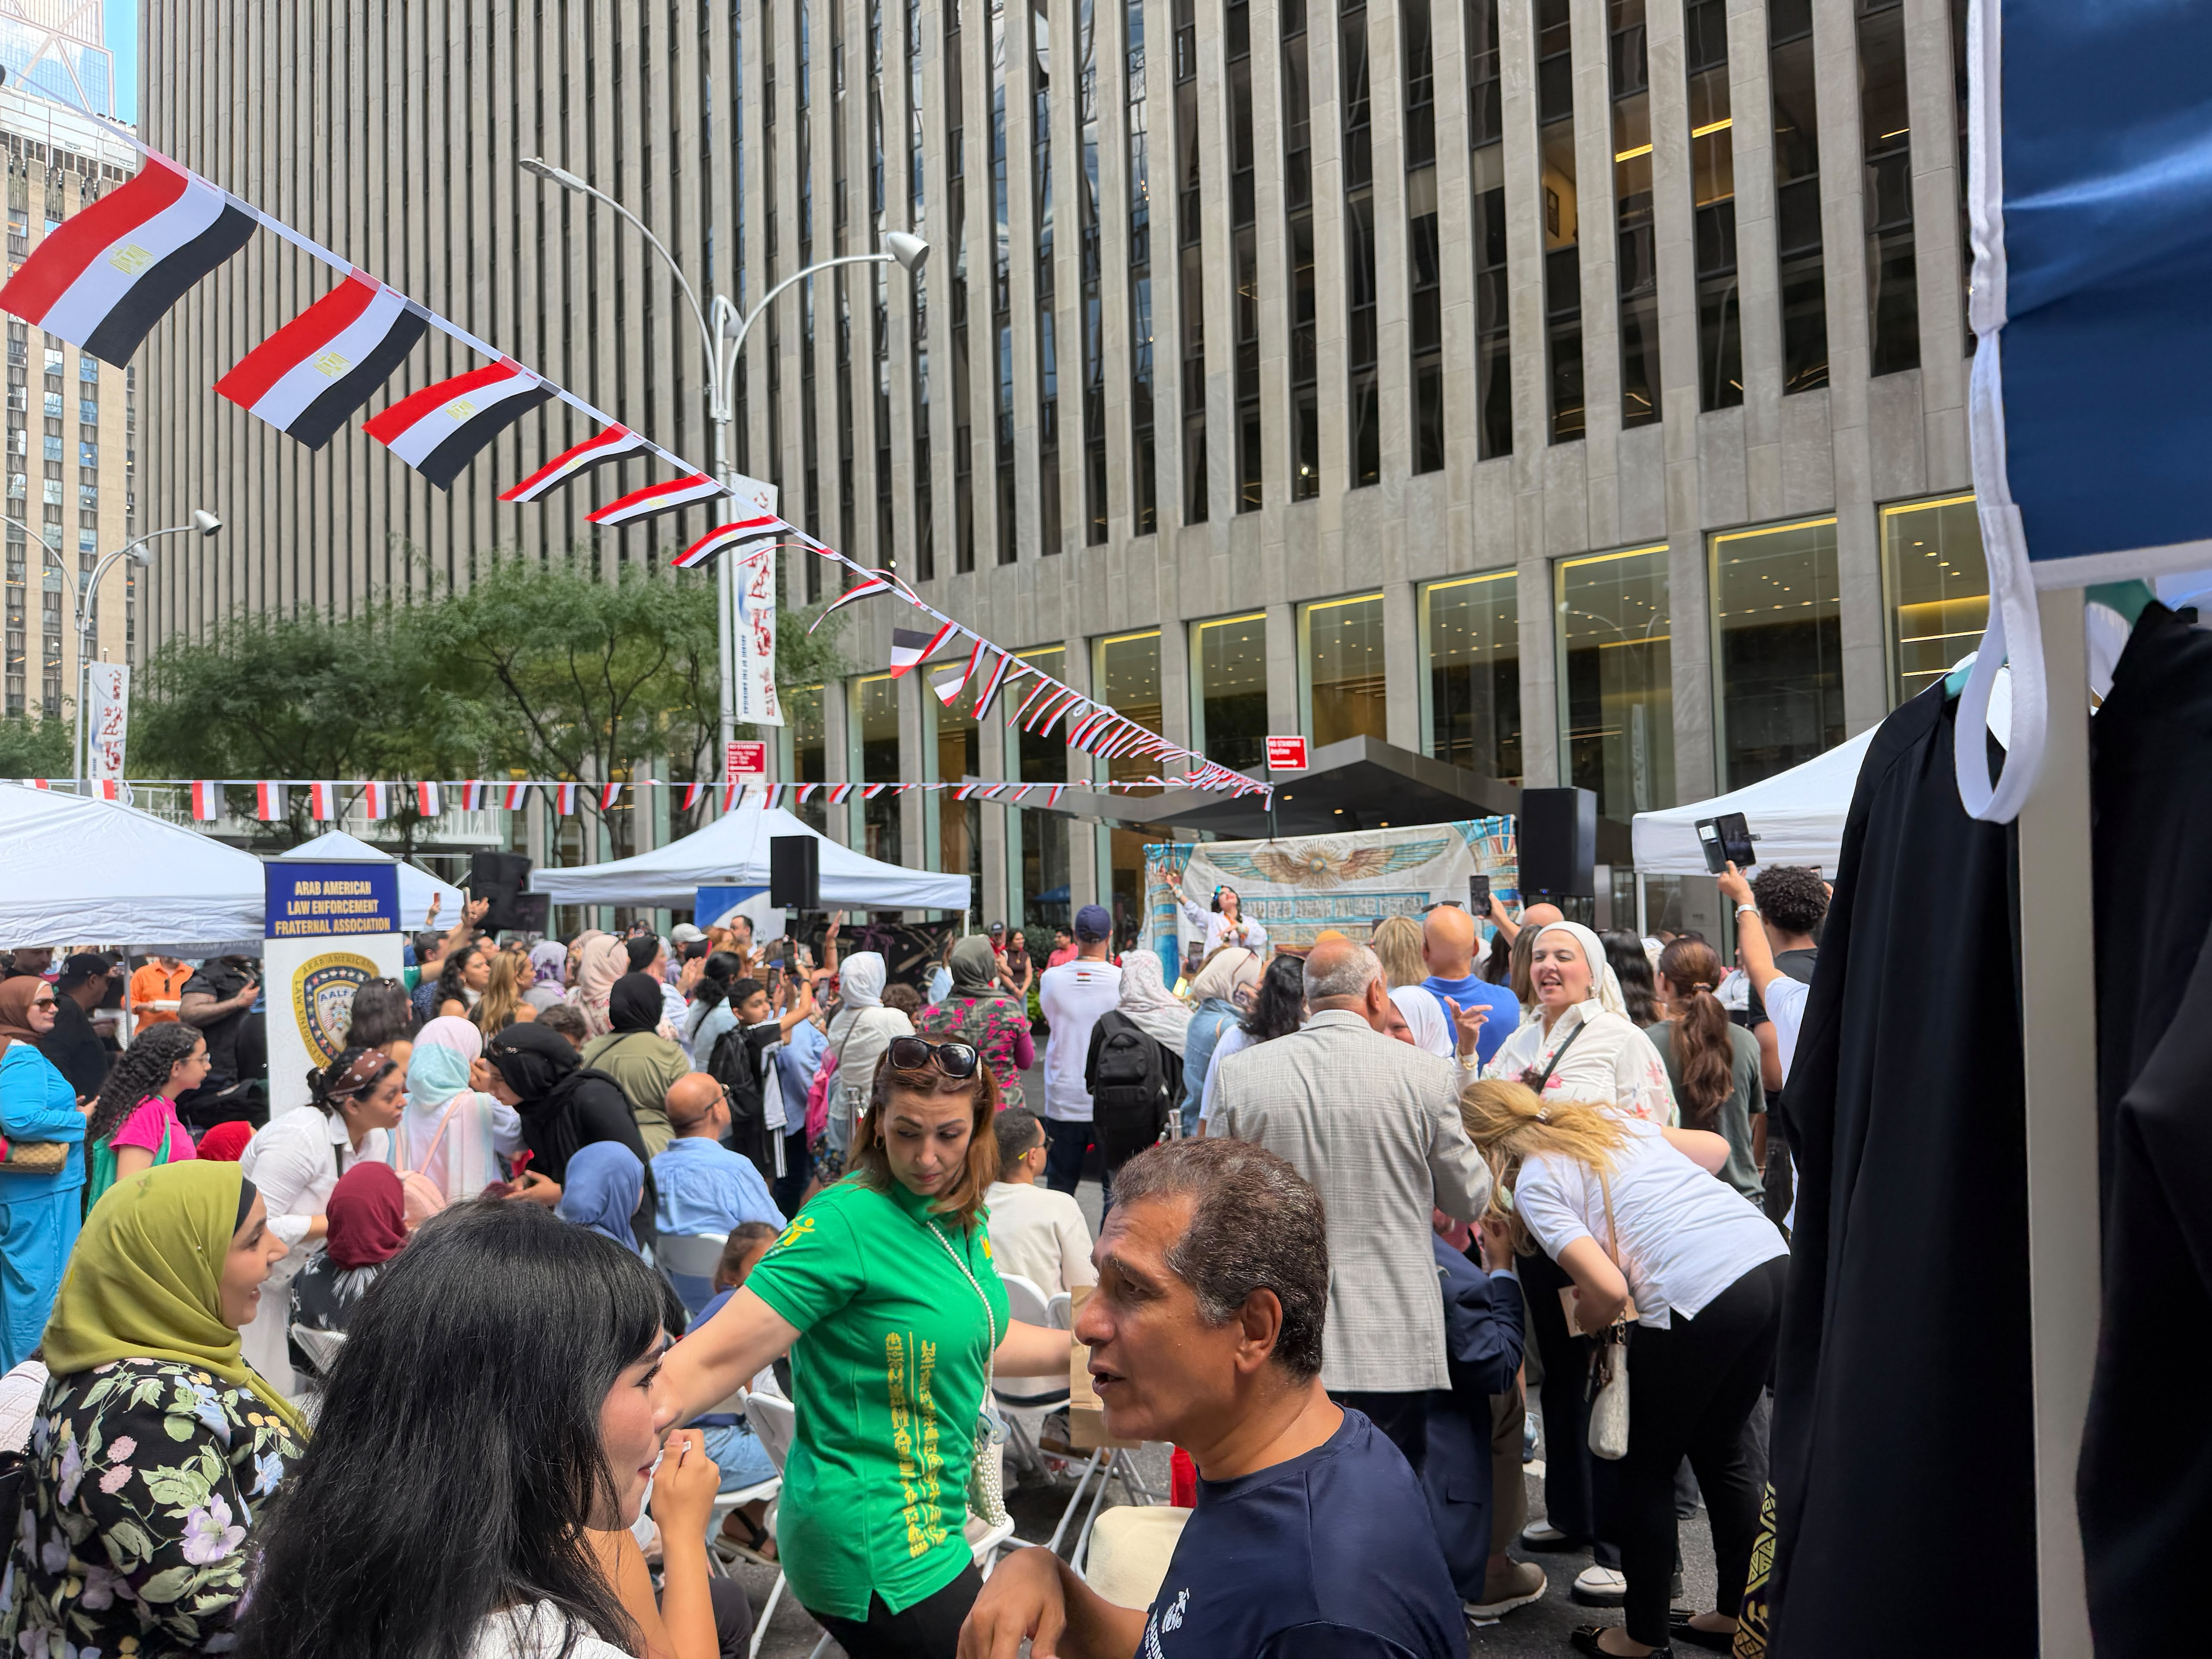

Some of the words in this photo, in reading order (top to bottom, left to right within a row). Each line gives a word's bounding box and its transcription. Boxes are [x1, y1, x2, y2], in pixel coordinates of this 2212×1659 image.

[295, 881, 321, 896] ARAB
[323, 880, 371, 896] AMERICAN
[287, 900, 310, 915] LAW
[311, 899, 378, 915] ENFORCEMENT
[275, 919, 331, 936] FRATERNAL
[333, 917, 390, 933] ASSOCIATION
[303, 957, 324, 975] ARAB
[327, 954, 375, 970] AMERICAN
